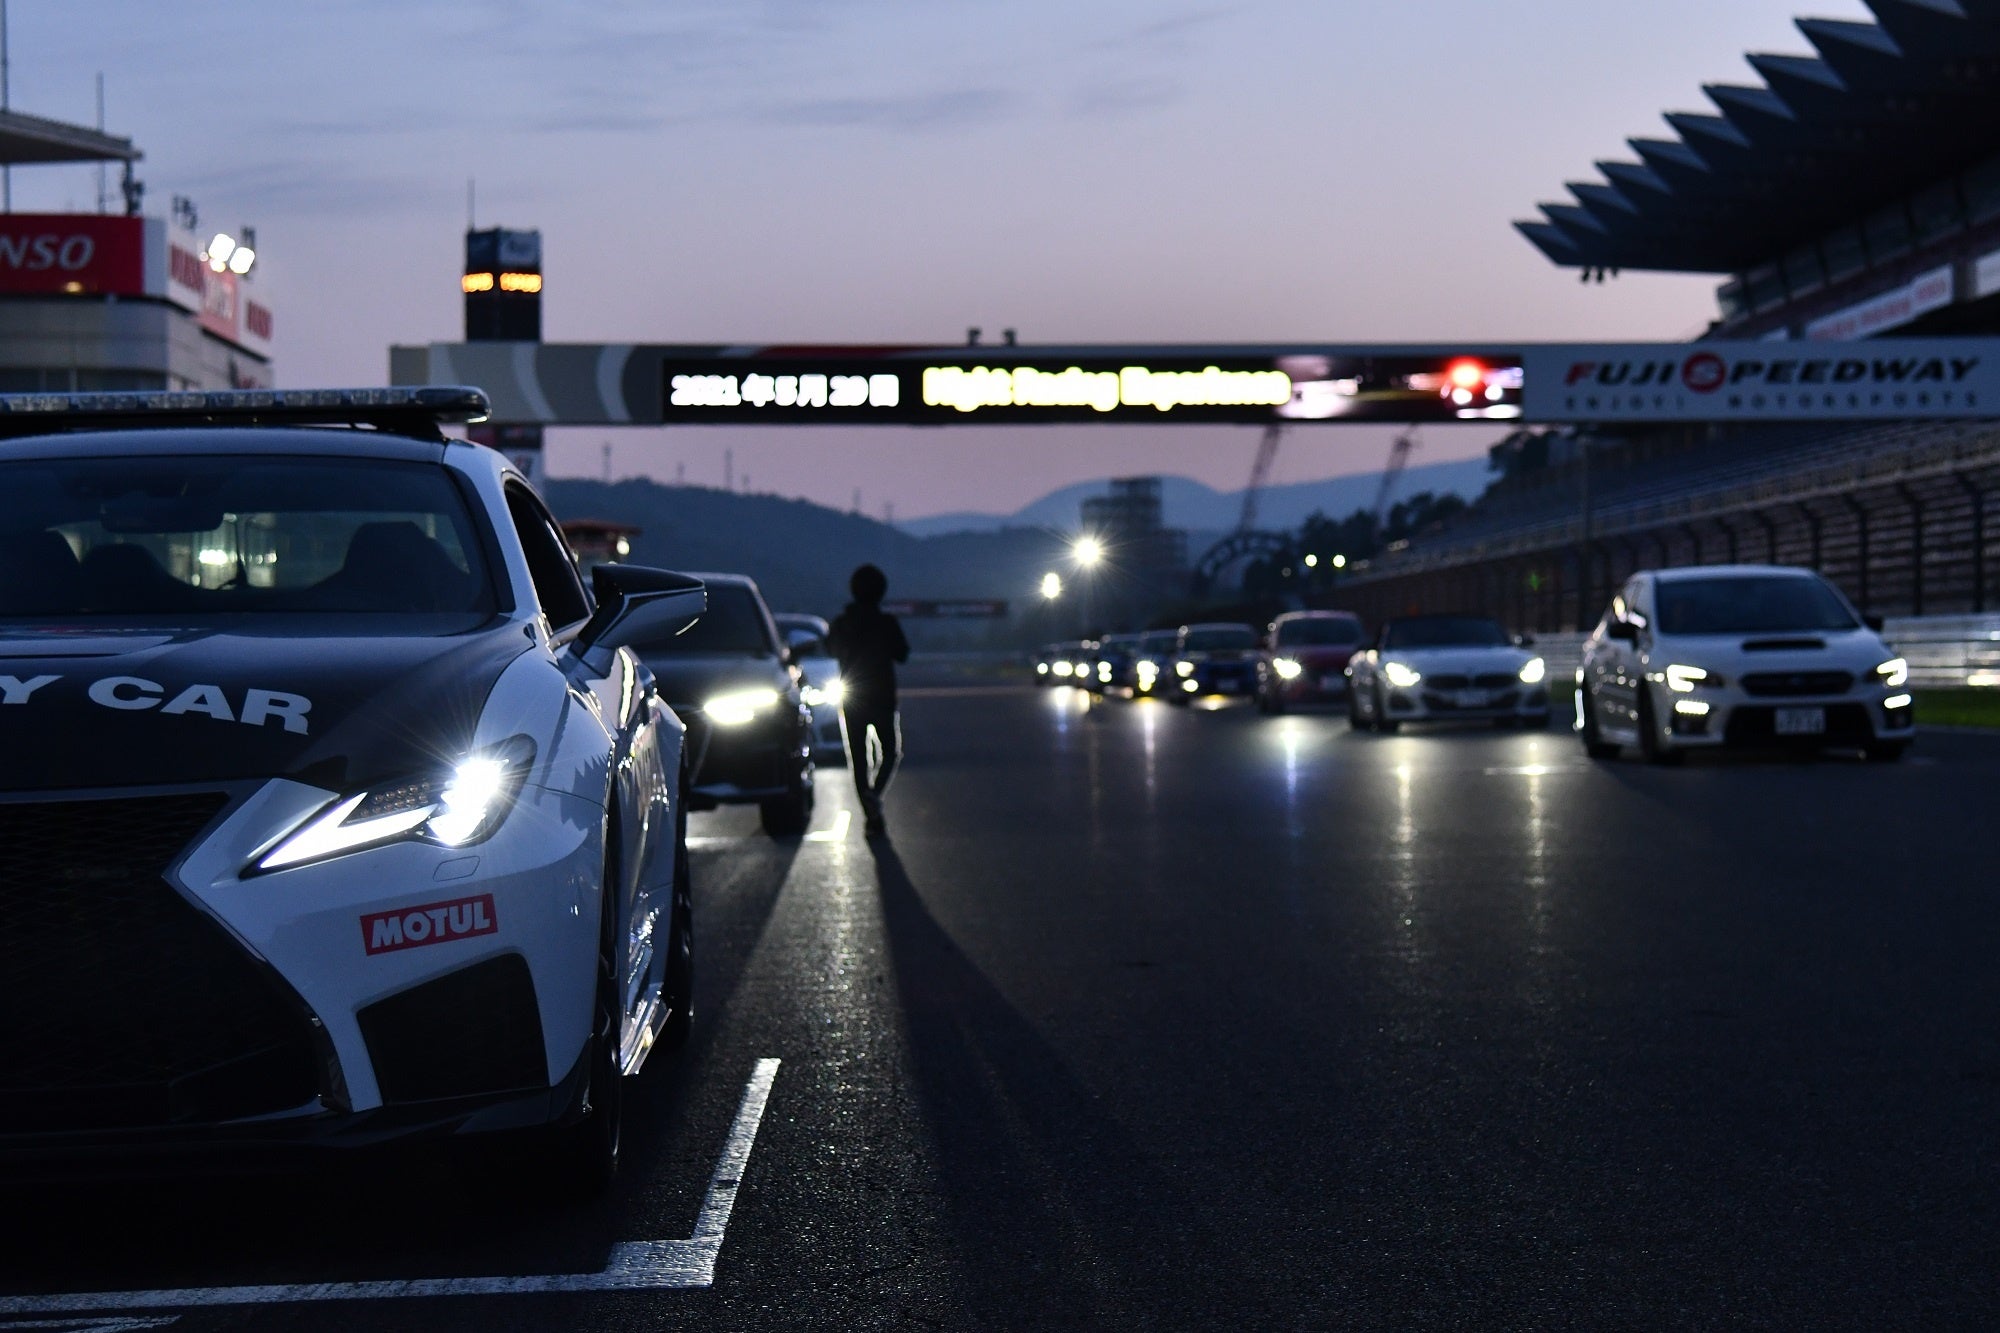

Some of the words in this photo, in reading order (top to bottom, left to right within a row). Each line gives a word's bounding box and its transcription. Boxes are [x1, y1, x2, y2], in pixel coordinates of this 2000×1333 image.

[1564, 360, 1676, 385] FUJI
[1727, 390, 1977, 410] MOTORSPORTS
[0, 675, 64, 704] Y
[88, 676, 312, 735] CAR
[371, 901, 490, 949] MOTUL
